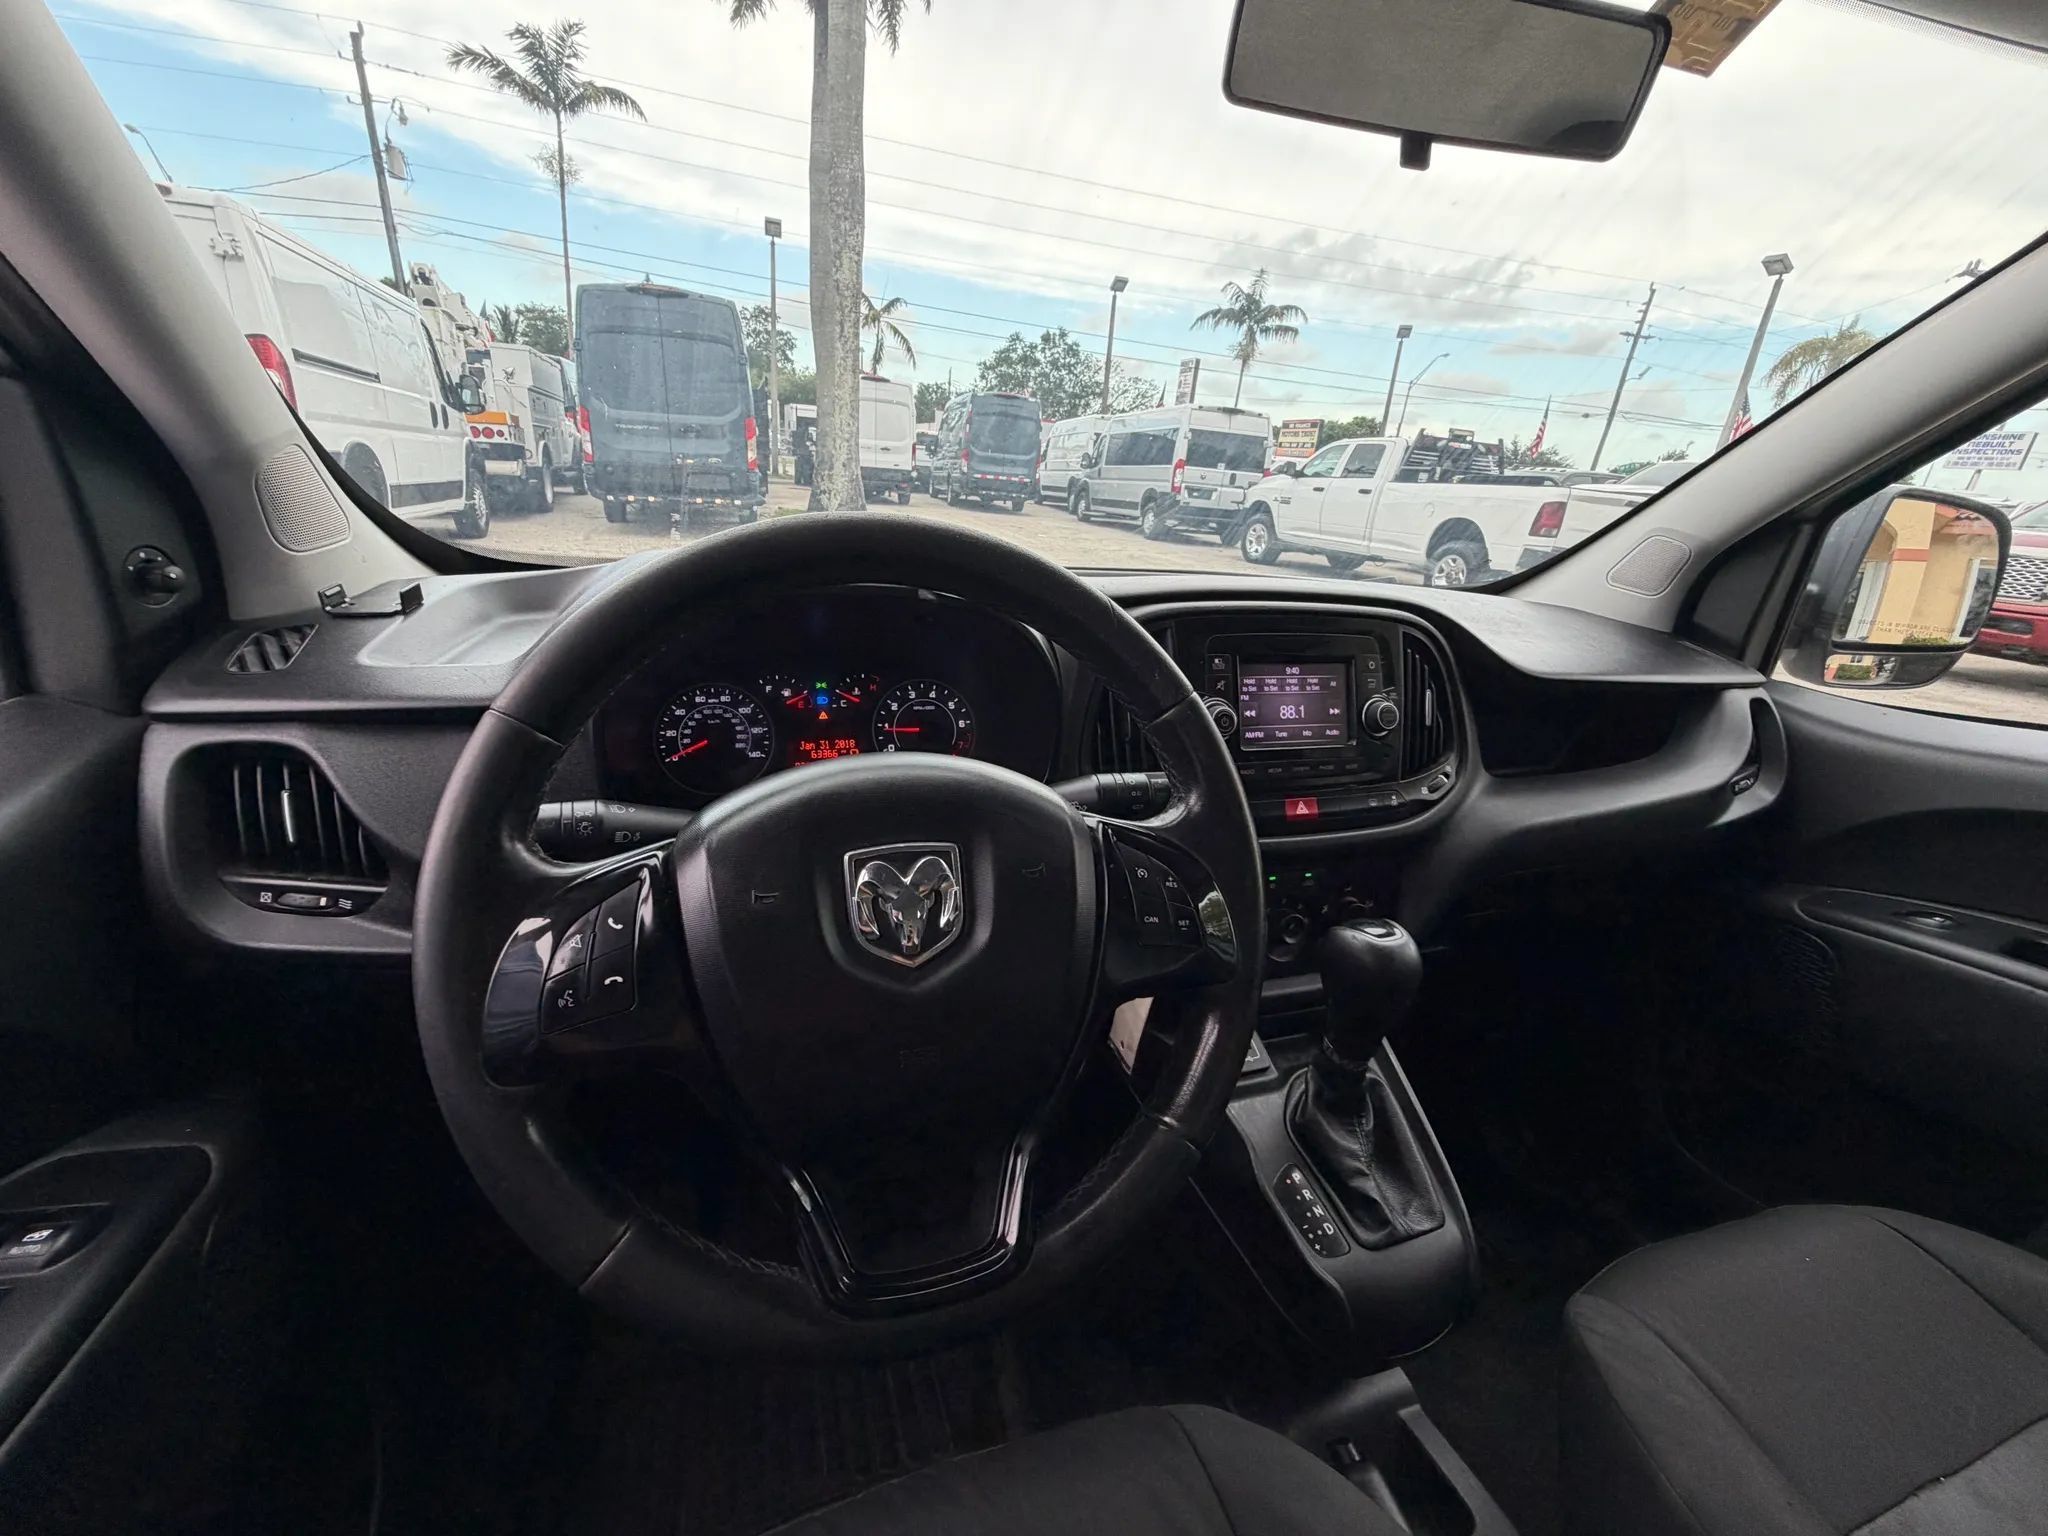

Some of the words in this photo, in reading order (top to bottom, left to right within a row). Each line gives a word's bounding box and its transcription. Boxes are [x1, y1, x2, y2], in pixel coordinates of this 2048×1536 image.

[1280, 705, 1305, 719] 88.1
[800, 741, 815, 750] Jan
[819, 740, 829, 749] 31
[835, 739, 856, 748] 2018
[1292, 1173, 1301, 1184] P
[1303, 1189, 1313, 1200] R
[1313, 1205, 1324, 1218] N
[1323, 1223, 1334, 1235] D
